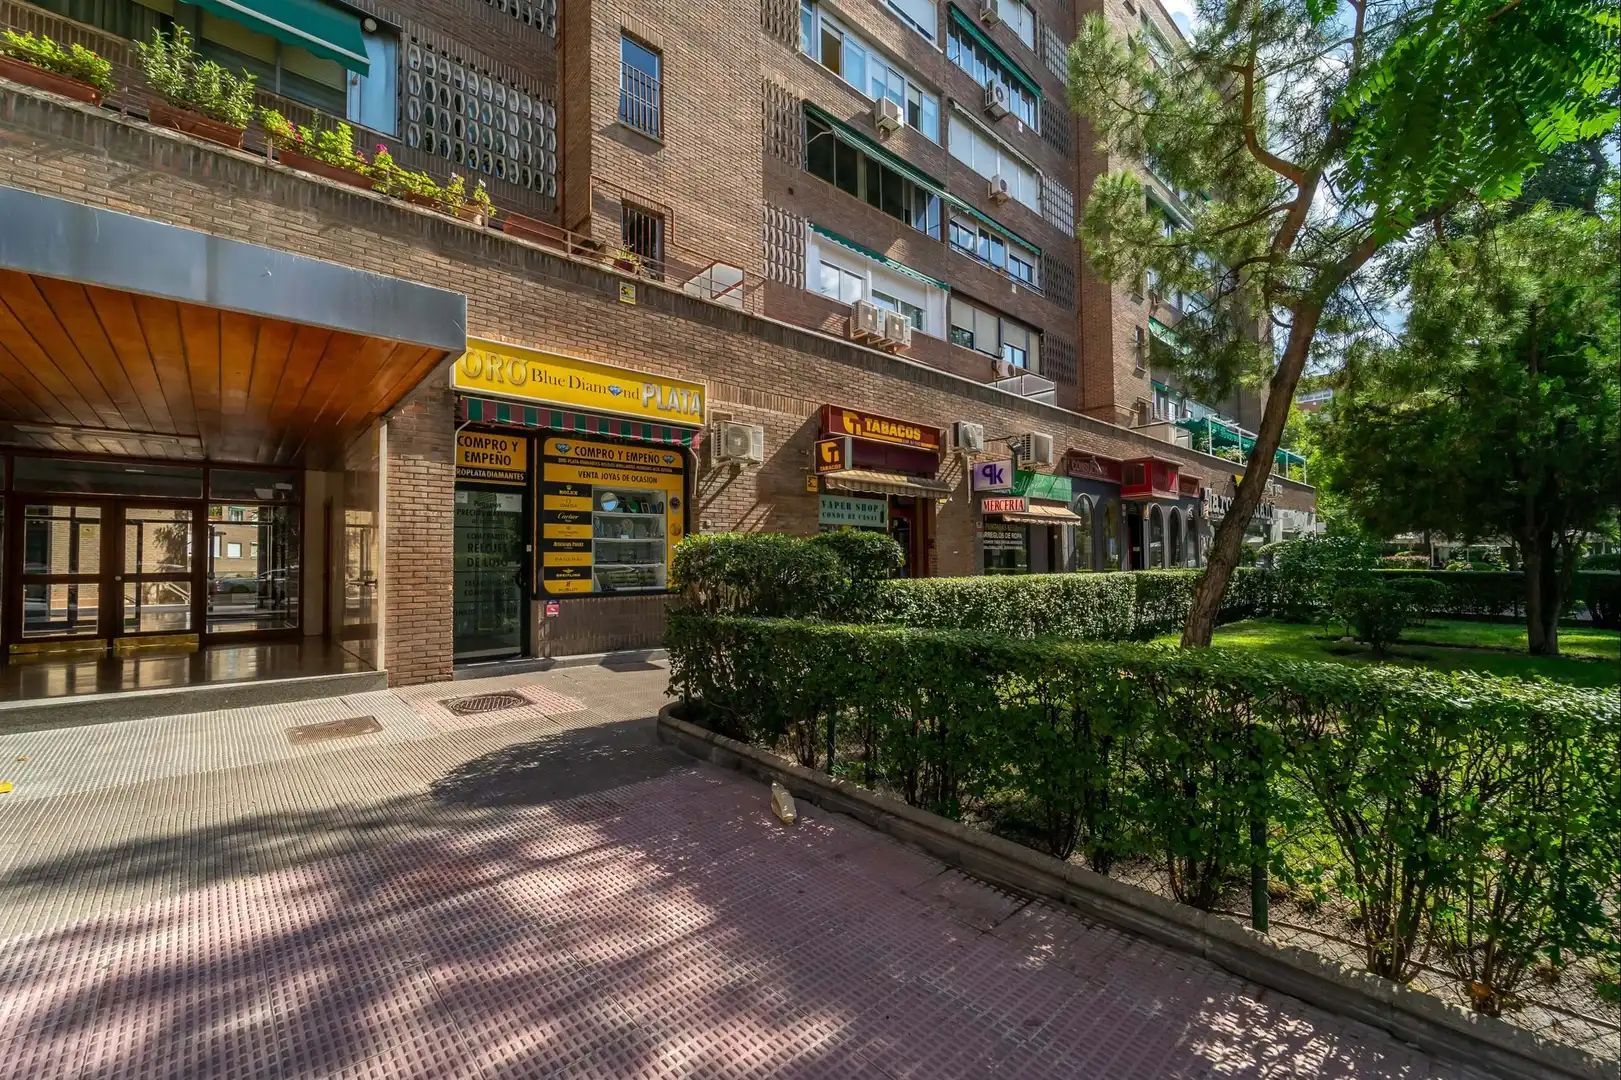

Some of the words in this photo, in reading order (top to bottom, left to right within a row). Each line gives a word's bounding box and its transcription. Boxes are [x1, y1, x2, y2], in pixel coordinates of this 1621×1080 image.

[459, 348, 527, 386] ORO
[531, 368, 566, 388] Blue
[568, 374, 641, 400] Diamnd
[642, 382, 704, 416] PLATA
[864, 417, 921, 440] TABACOS
[457, 436, 508, 452] COMPRO
[511, 441, 519, 453] Y
[464, 451, 512, 466] EMPEÑO
[574, 446, 615, 460] COMPRO
[616, 450, 623, 461] Y
[626, 451, 660, 464] EMPEÑO
[819, 463, 842, 471] TABACOS
[578, 470, 600, 480] VENTA
[601, 472, 620, 482] JOYAS
[622, 474, 630, 482] DE
[631, 475, 658, 485] OCASION
[822, 500, 852, 511] VAPER
[855, 503, 879, 513] SHOP
[983, 499, 1024, 512] MERCERIA
[822, 511, 845, 520] CONDE
